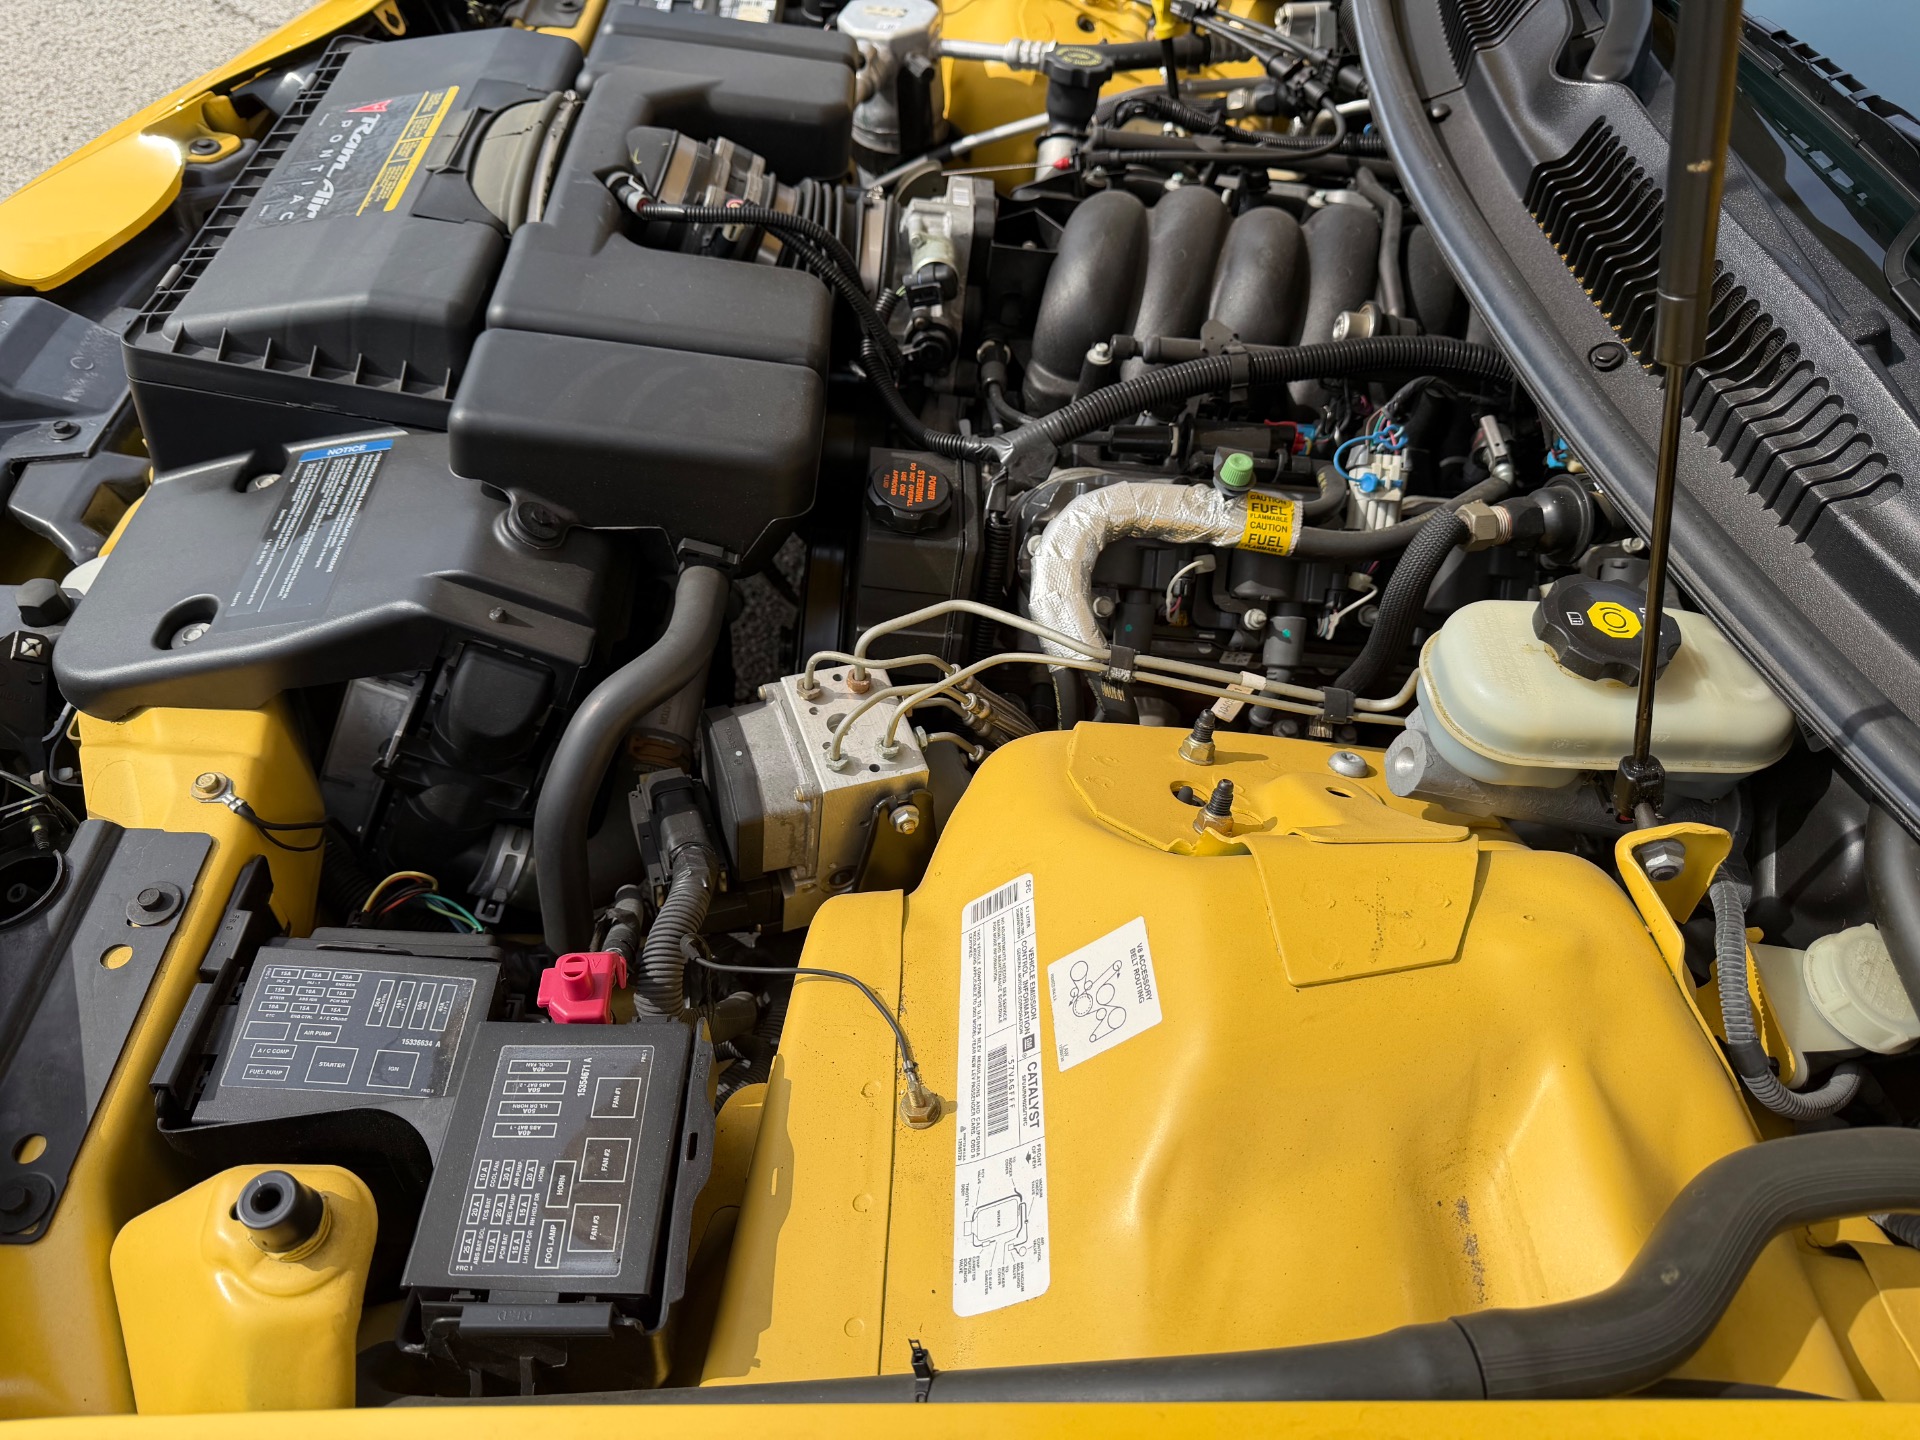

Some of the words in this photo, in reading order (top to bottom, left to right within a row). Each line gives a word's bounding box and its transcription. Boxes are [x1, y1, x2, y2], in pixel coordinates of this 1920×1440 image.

[328, 444, 367, 456] NOTICE
[915, 470, 925, 502] STEERING
[928, 476, 936, 500] POWER
[906, 484, 914, 507] OVERFILL
[1250, 494, 1288, 504] CAUTION
[1251, 502, 1288, 516] FUEL
[1250, 514, 1288, 522] FLAMMABLE
[1250, 522, 1288, 532] CAUTION
[1248, 534, 1284, 548] FUEL
[1244, 544, 1283, 553] FLAMMABLE
[1137, 942, 1144, 953] V8
[1130, 948, 1138, 966] BELT
[1134, 968, 1144, 1004] ROUTING
[1138, 955, 1152, 1001] ACCESSORY
[577, 1065, 590, 1096] 15354671
[1028, 1062, 1040, 1128] CATALYST
[603, 1148, 610, 1156] #2
[601, 1157, 609, 1171] FAN
[490, 1173, 498, 1188] COOL
[526, 1174, 533, 1182] 20
[557, 1175, 566, 1195] HORN
[471, 1208, 478, 1217] 20
[495, 1208, 502, 1217] 20
[519, 1208, 526, 1216] 15
[530, 1218, 536, 1226] RH
[592, 1216, 600, 1224] #3
[527, 1230, 533, 1238] DR
[548, 1225, 556, 1246] LAMP
[590, 1226, 598, 1240] FAN
[462, 1246, 470, 1254] 25
[511, 1246, 519, 1254] 15
[544, 1247, 553, 1264] FOG
